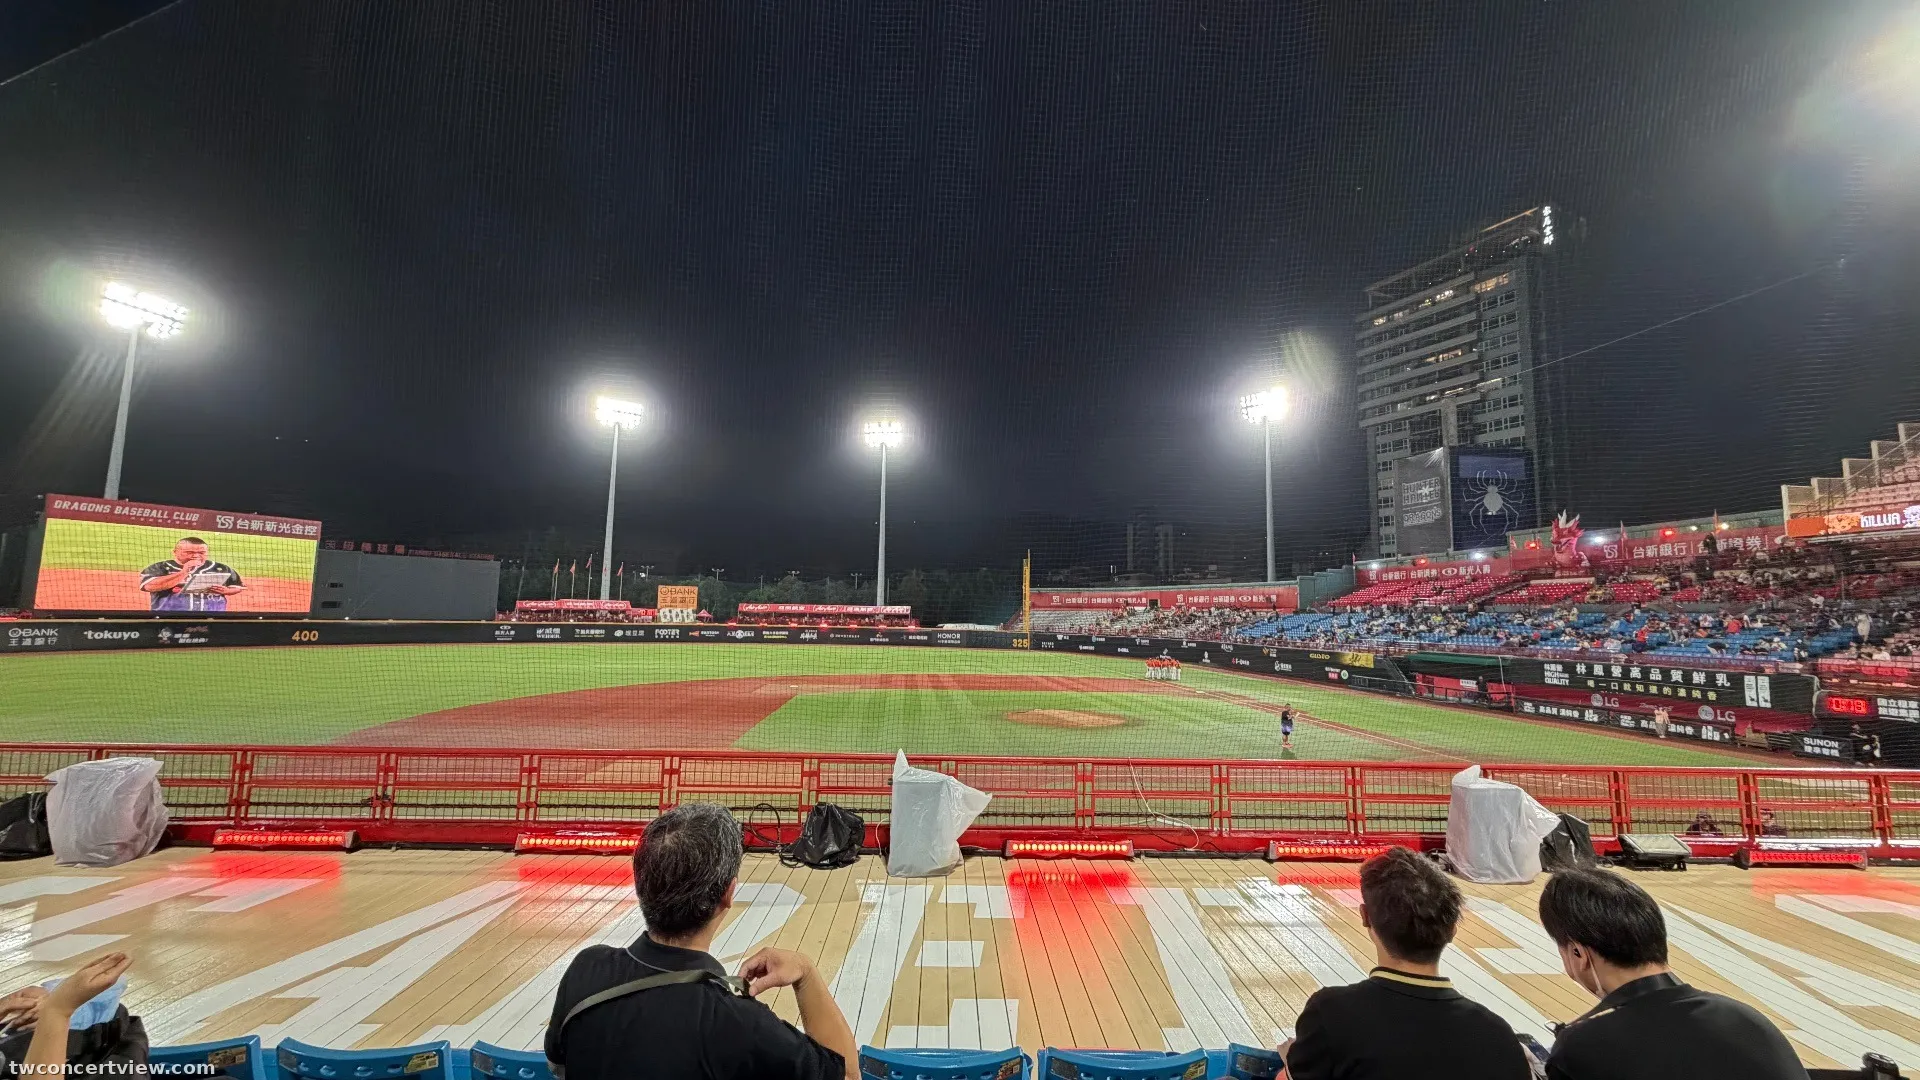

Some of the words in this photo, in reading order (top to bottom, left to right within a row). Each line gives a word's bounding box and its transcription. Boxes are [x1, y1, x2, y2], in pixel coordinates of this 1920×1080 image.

[53, 499, 112, 514] DRAGONS
[114, 506, 169, 520] BASEBALL
[173, 511, 200, 522] CLUB
[1860, 513, 1901, 528] KILLUA
[236, 518, 318, 537] 台新新光金控
[1632, 542, 1688, 559] 台新銀行
[84, 630, 140, 641] tokuyo
[291, 630, 319, 642] 400
[937, 632, 961, 640] HONOR
[8, 637, 58, 647] 王道銀行
[1012, 638, 1028, 648] 325
[1544, 671, 1559, 679] HIGH
[1576, 664, 1731, 687] 林鳳營高品質鮮乳
[1544, 678, 1570, 686] QUALITY
[1604, 696, 1620, 707] LG
[1716, 709, 1736, 722] LG
[1803, 736, 1839, 748] SUNON
